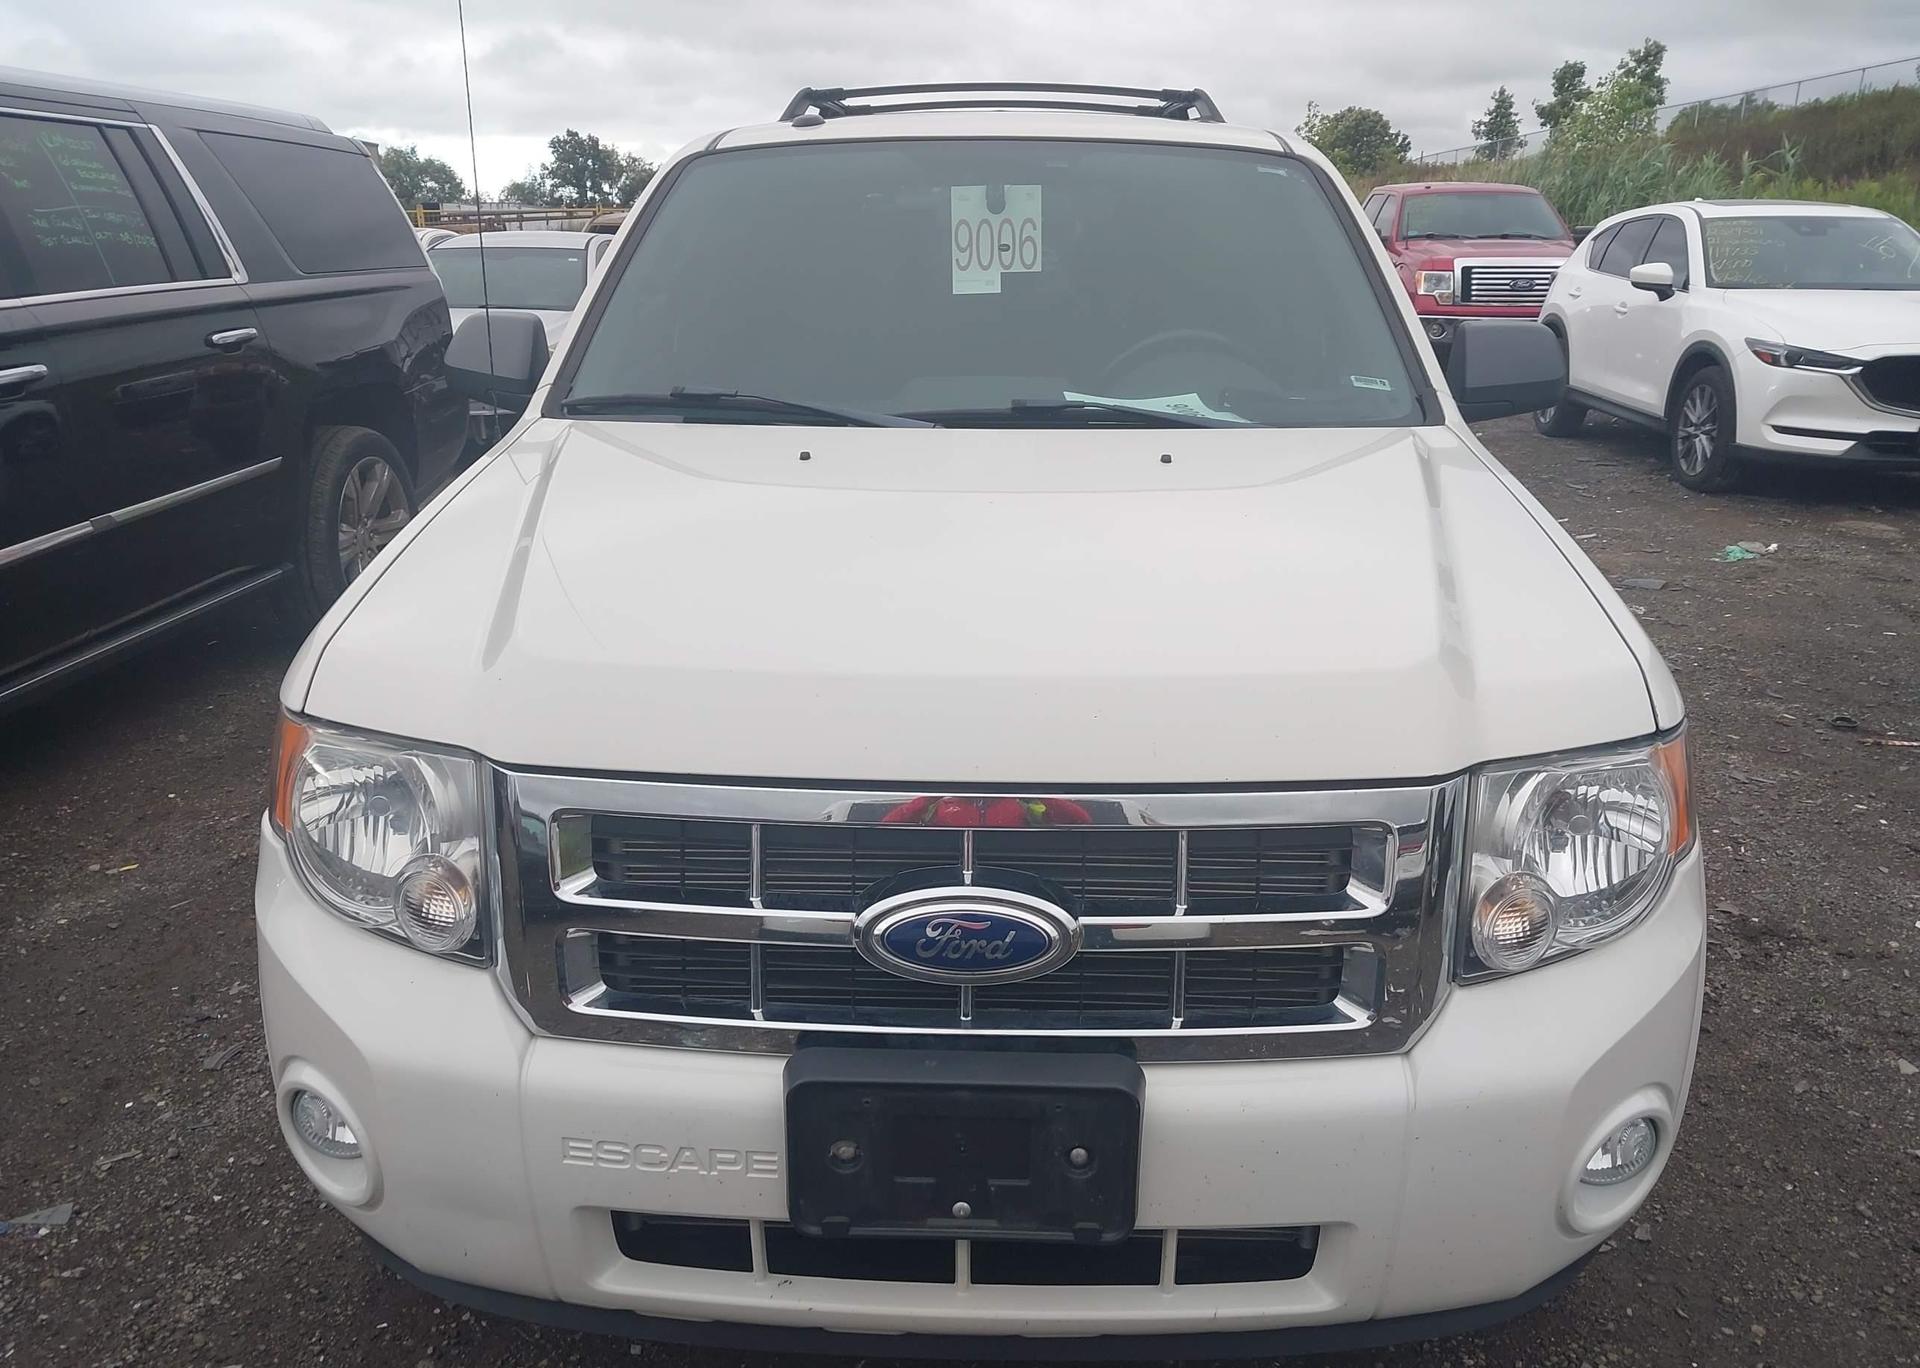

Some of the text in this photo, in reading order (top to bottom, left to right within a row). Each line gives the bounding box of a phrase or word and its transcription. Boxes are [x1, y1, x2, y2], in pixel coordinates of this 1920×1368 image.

[954, 217, 1038, 271] 9006
[915, 918, 1013, 959] Ford
[561, 1137, 778, 1178] ESCAPE
